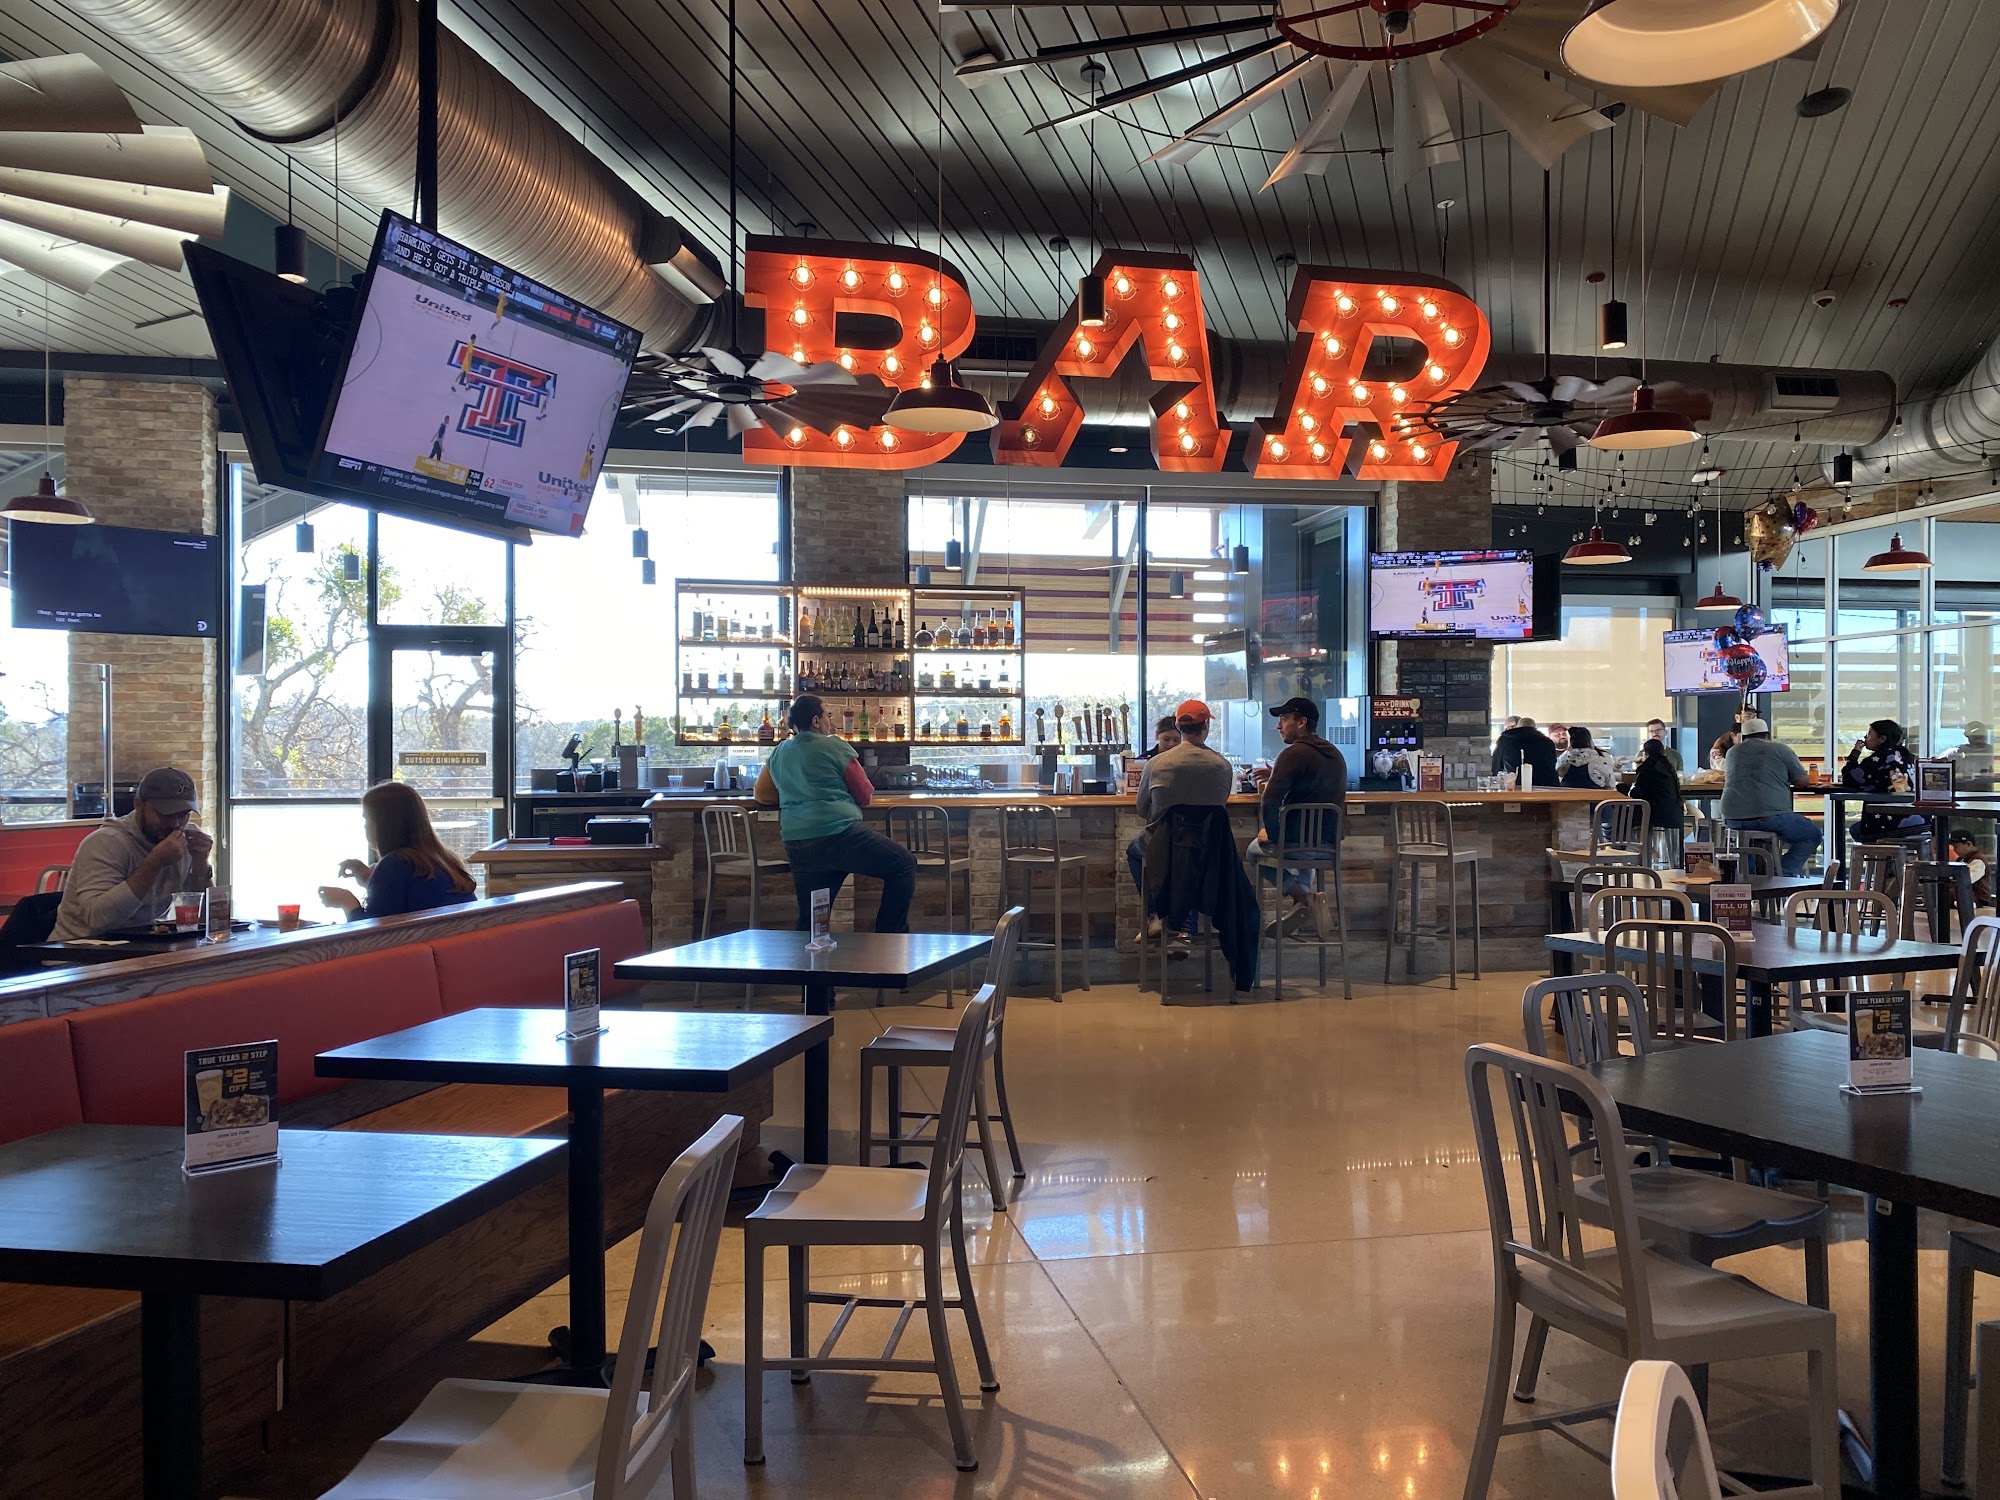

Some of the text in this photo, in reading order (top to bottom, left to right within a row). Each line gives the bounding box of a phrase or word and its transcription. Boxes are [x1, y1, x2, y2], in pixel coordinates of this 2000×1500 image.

[394, 244, 484, 293] AND HE'S GOT A TRIPLE.
[400, 231, 514, 292] HAWKINS, GETS IT TO ANDERSON.
[415, 294, 472, 322] United
[743, 235, 1490, 480] BAR
[338, 458, 362, 472] ESPN
[367, 464, 376, 472] AFC
[384, 468, 404, 479] Steelers
[410, 474, 428, 484] Ravens
[484, 476, 495, 488] 62
[1727, 656, 1754, 666] Happy
[1390, 700, 1410, 708] DRINK
[198, 1056, 216, 1066] TRUE
[218, 1053, 240, 1063] TEXAS
[251, 1050, 268, 1059] STEP
[226, 1068, 248, 1084] $2
[228, 1084, 248, 1093] OFF
